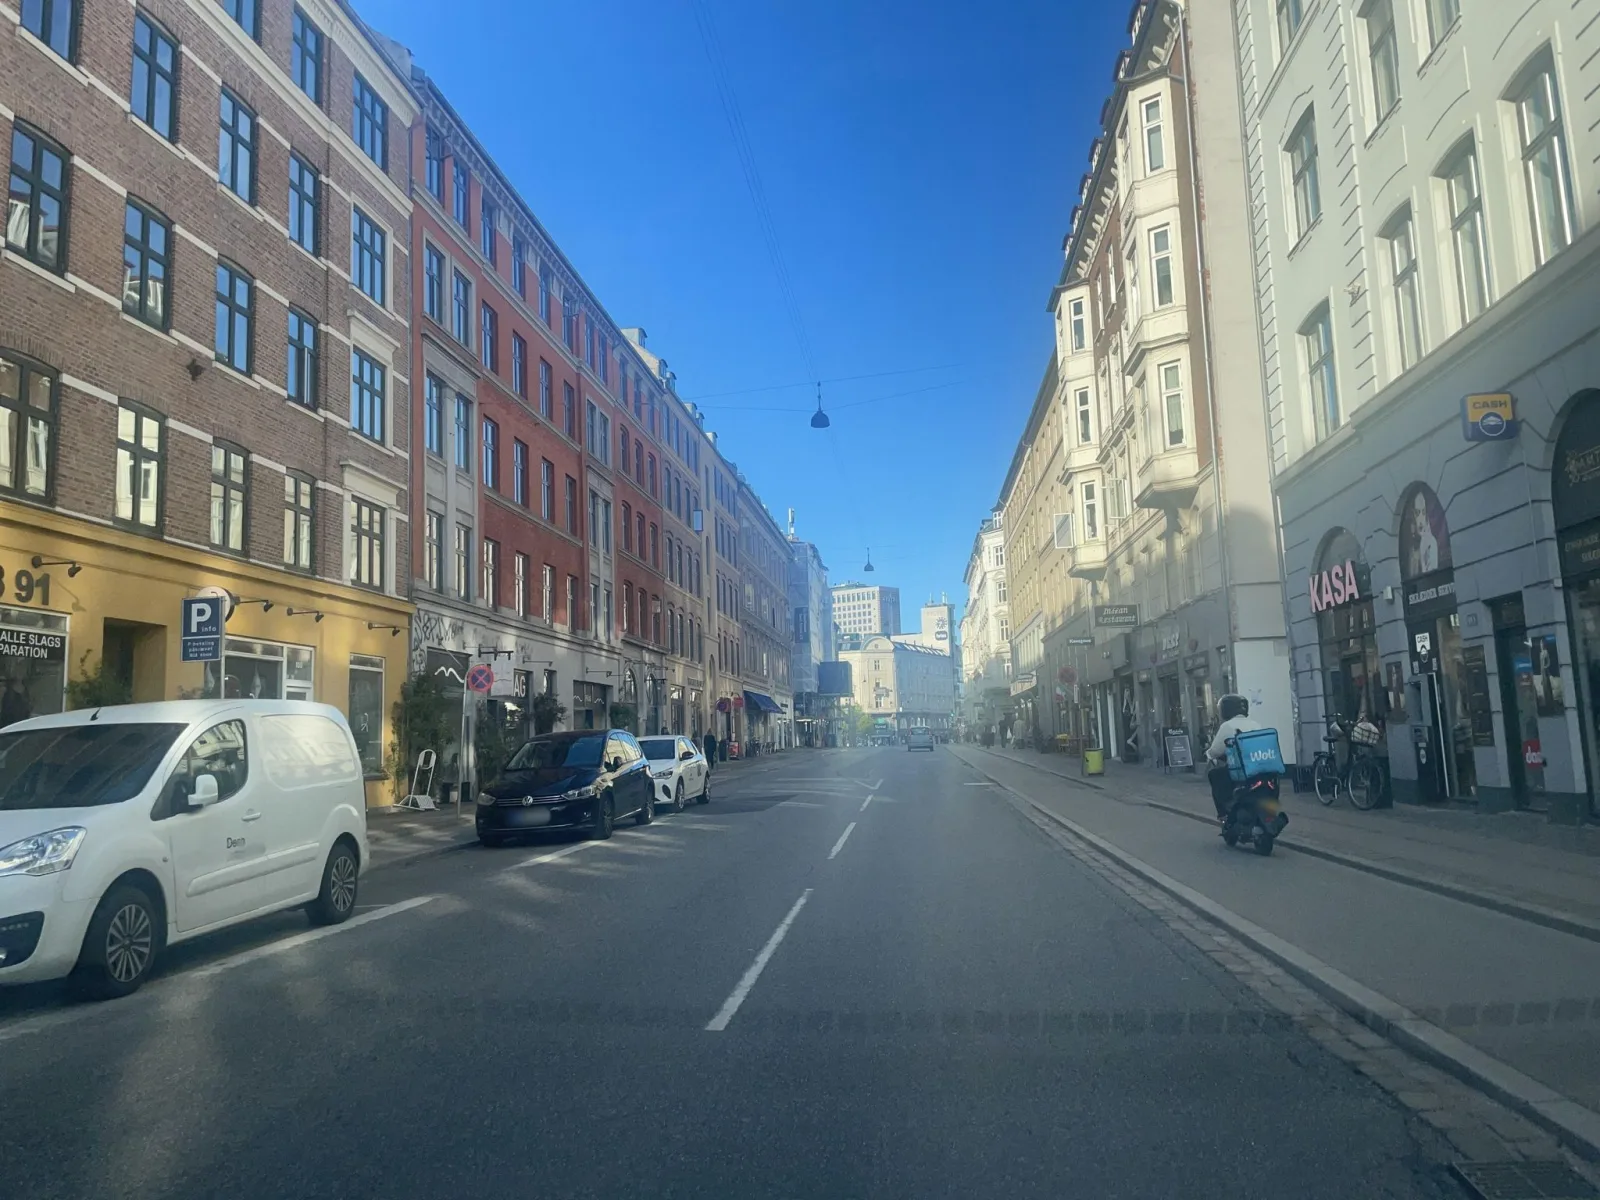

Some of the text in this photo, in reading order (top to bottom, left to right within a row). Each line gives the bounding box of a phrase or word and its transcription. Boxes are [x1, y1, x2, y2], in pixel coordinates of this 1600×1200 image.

[1472, 400, 1507, 410] CASH
[15, 569, 50, 606] 91
[1309, 560, 1359, 613] KASA
[191, 603, 212, 632] P
[0, 630, 61, 648] ALLE SLAGS
[1249, 749, 1277, 762] Wolt
